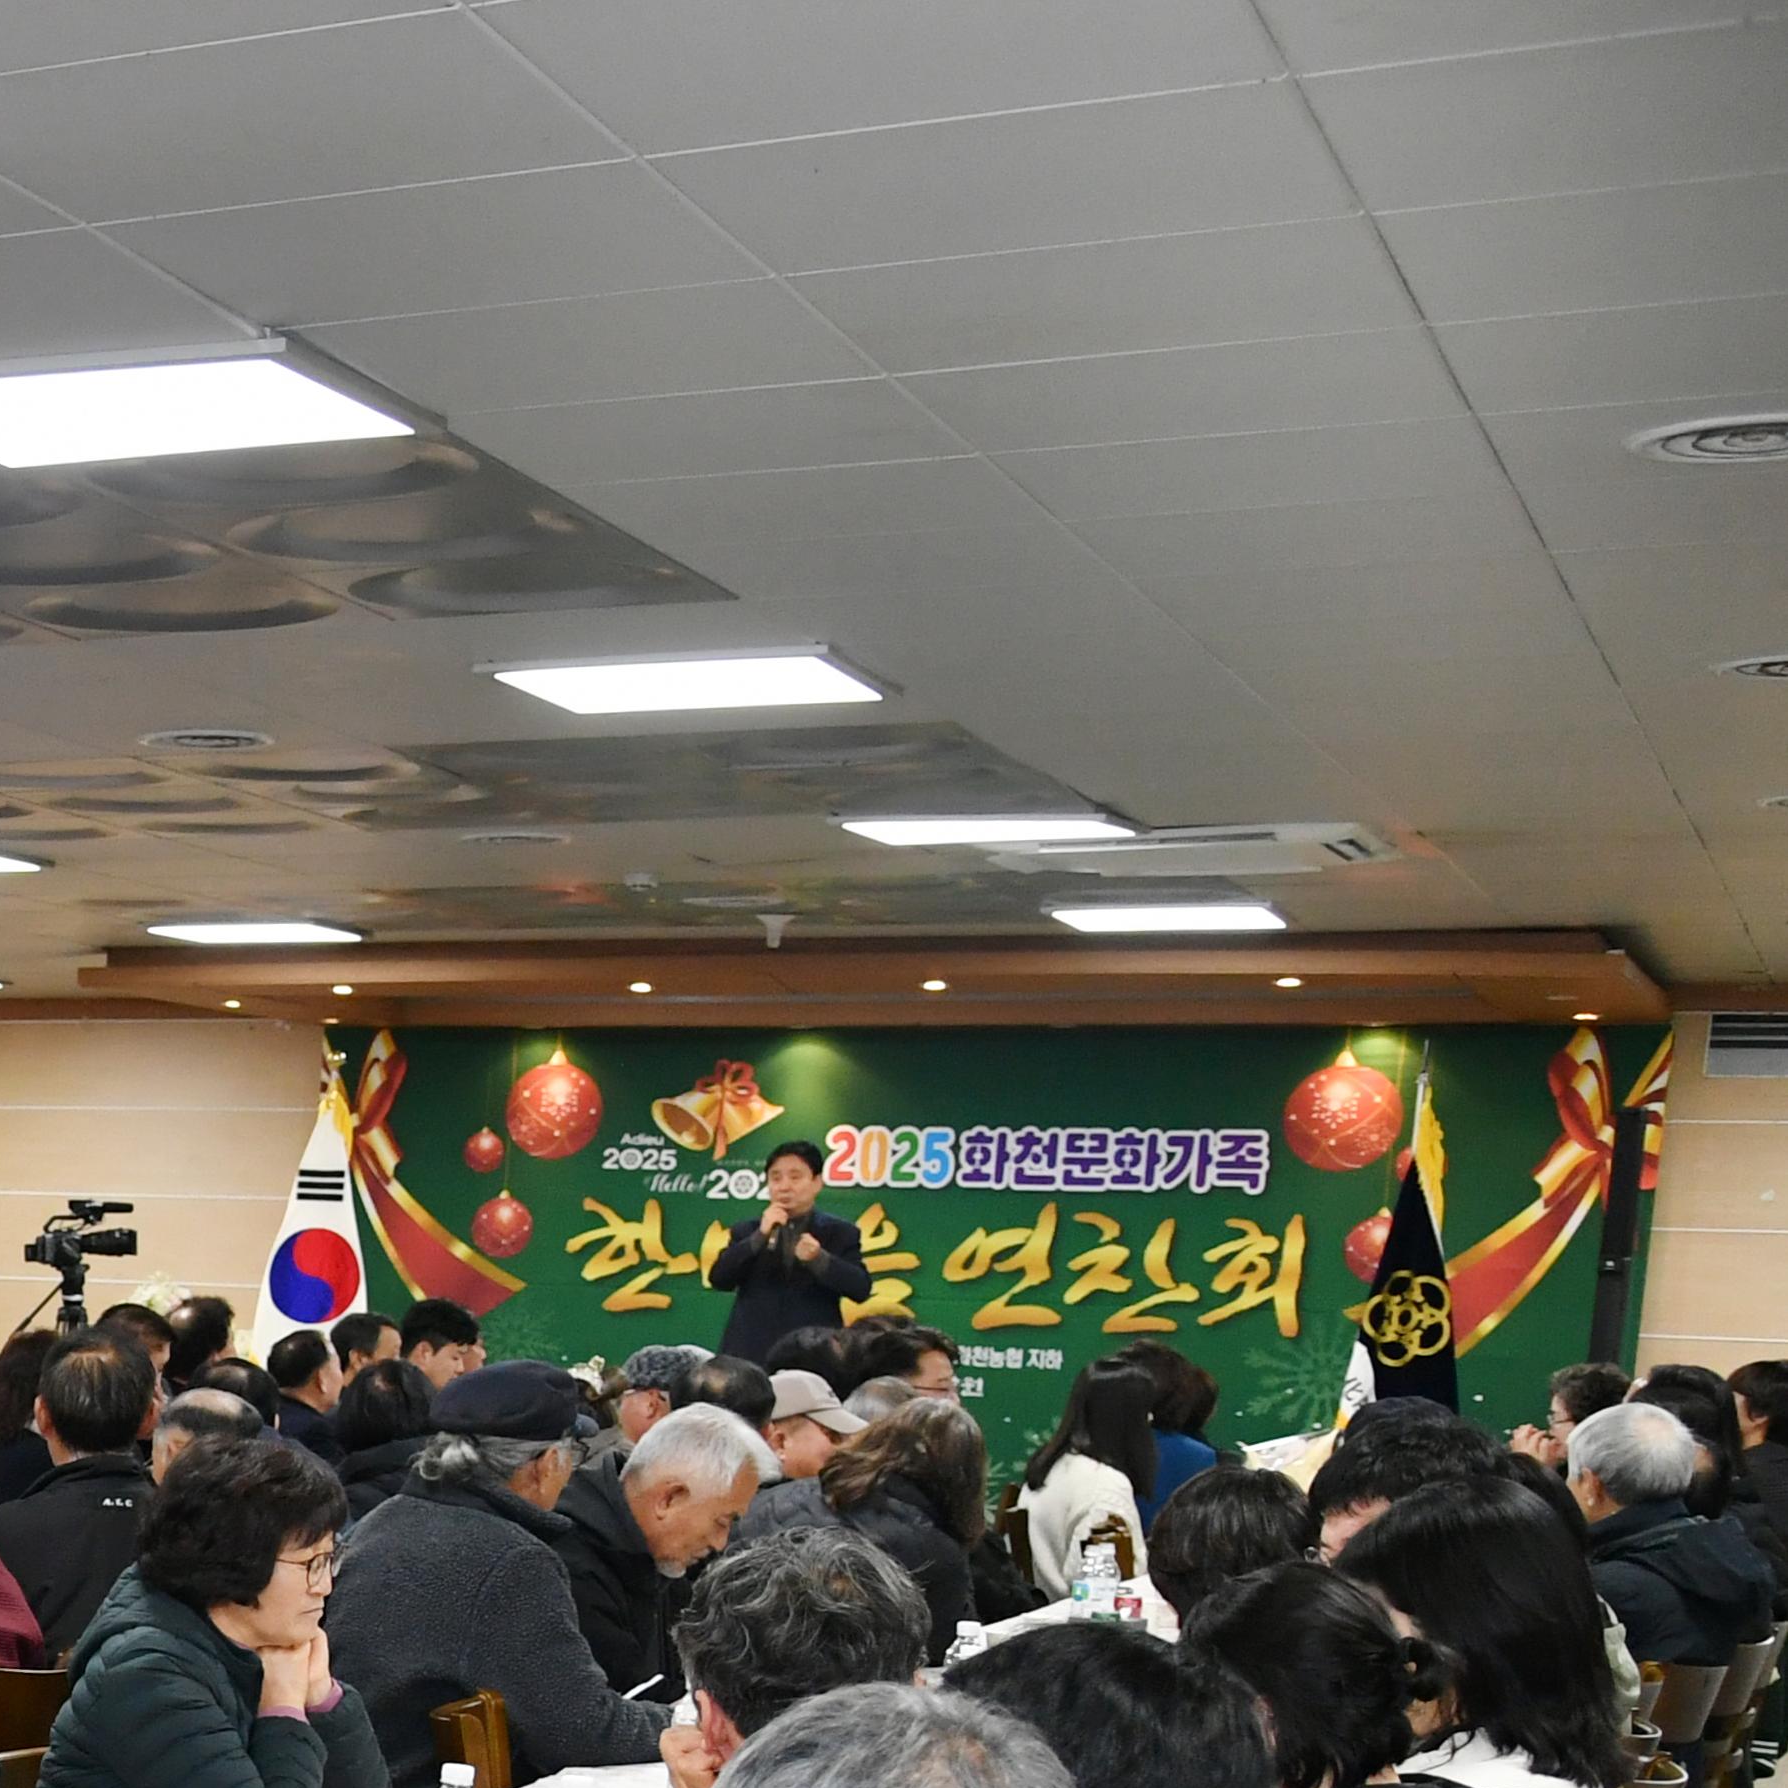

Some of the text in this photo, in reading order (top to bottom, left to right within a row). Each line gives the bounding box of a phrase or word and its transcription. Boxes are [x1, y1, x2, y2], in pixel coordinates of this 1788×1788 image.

[620, 1132, 665, 1147] Adieu
[602, 1148, 677, 1171] 2025
[825, 1126, 1269, 1194] 2025 화천문화가족
[706, 1168, 772, 1200] 202
[565, 1198, 1305, 1338] 한음 연찬회
[1025, 1348, 1064, 1370] 지하
